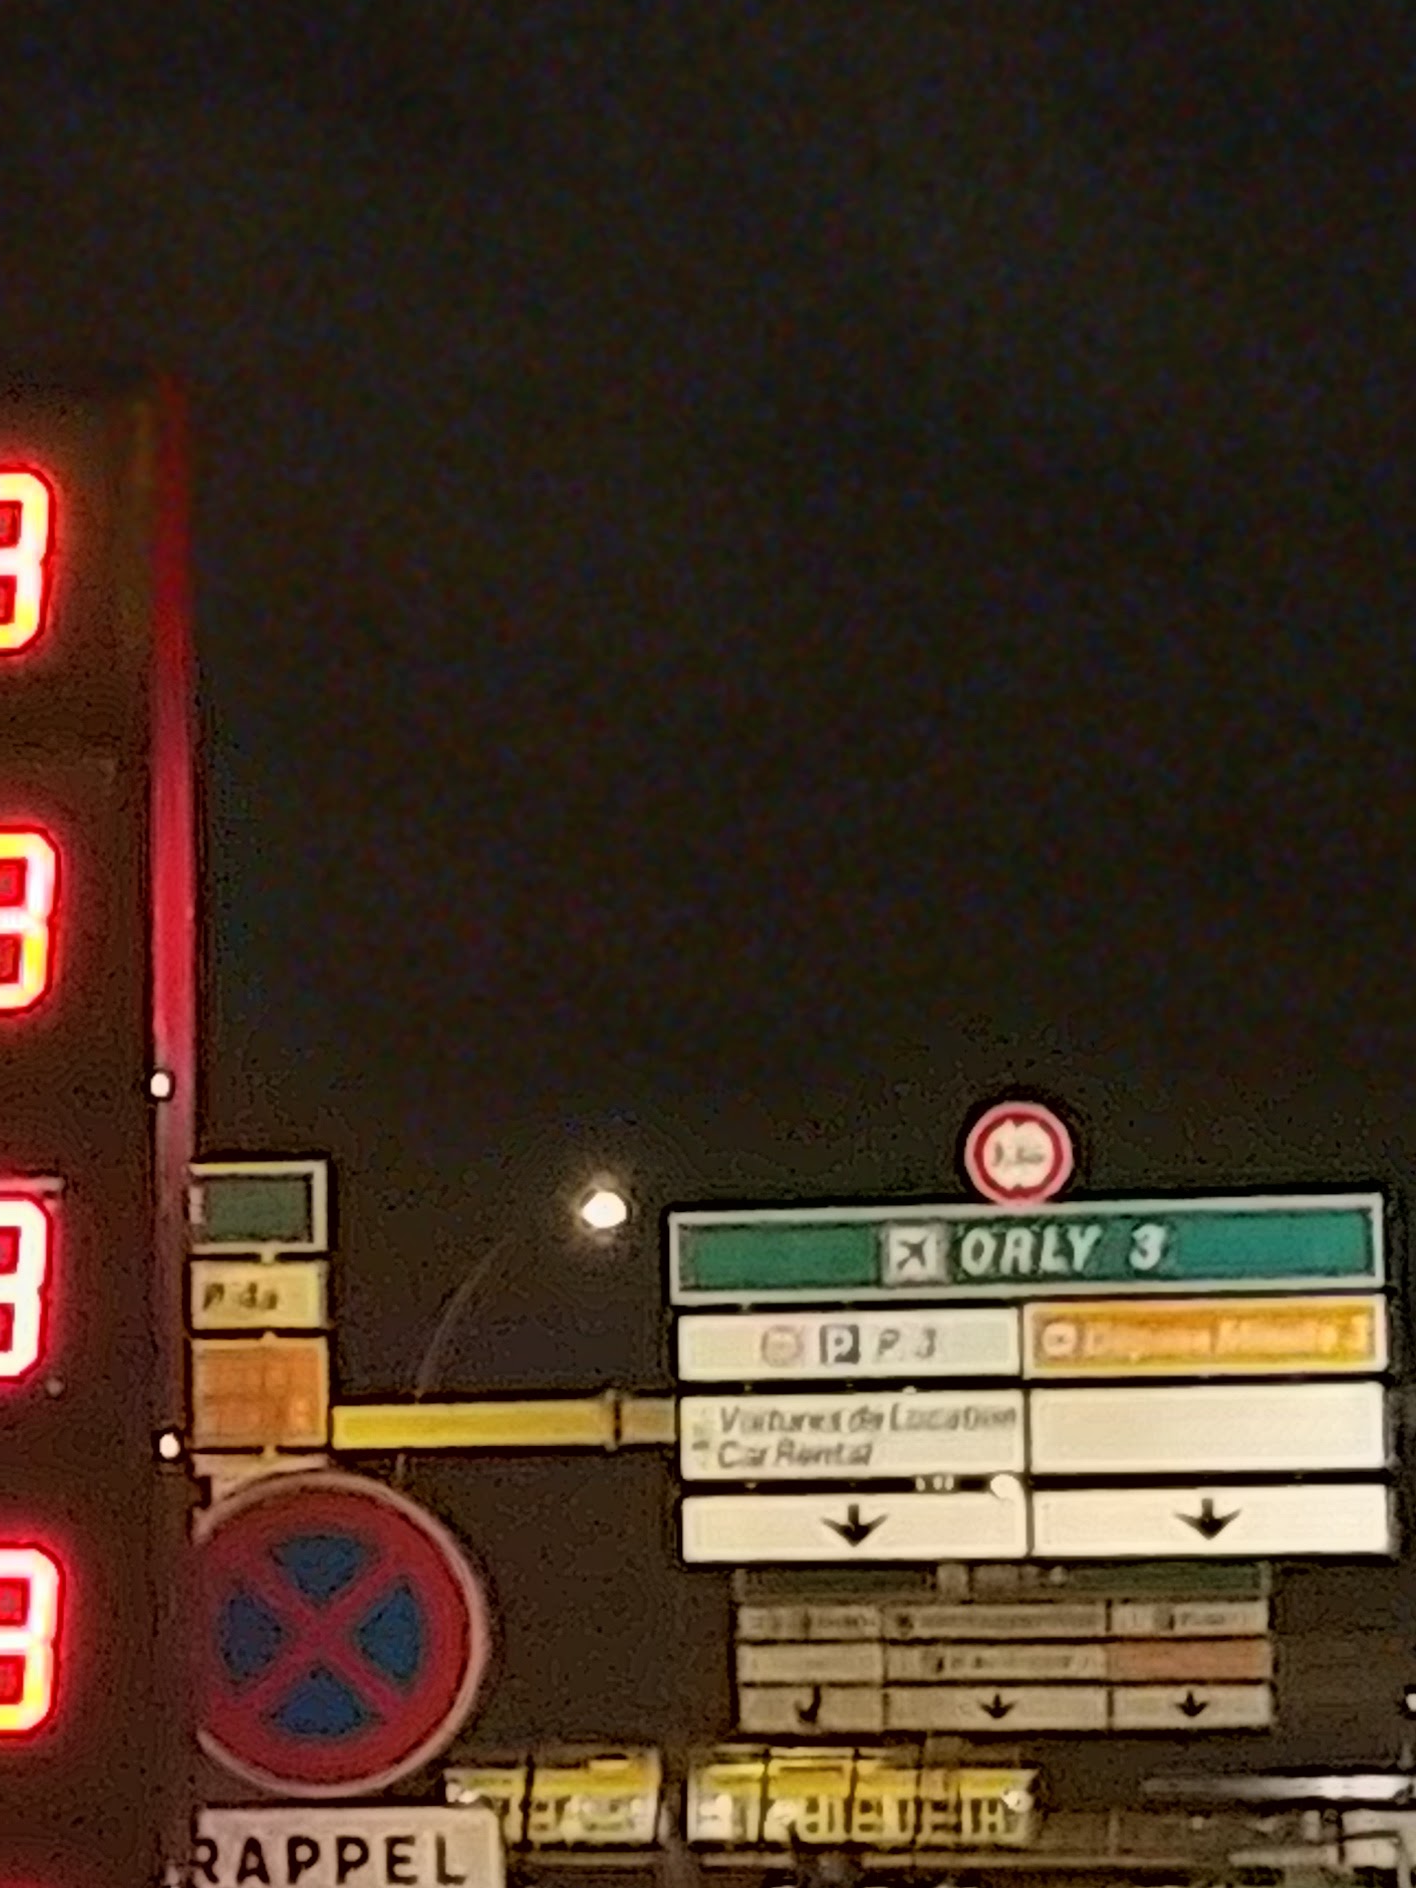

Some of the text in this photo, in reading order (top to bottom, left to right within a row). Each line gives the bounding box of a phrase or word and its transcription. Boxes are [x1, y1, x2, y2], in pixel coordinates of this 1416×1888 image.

[961, 1223, 1167, 1278] ORLY 3
[192, 1835, 467, 1885] RAPPEL
